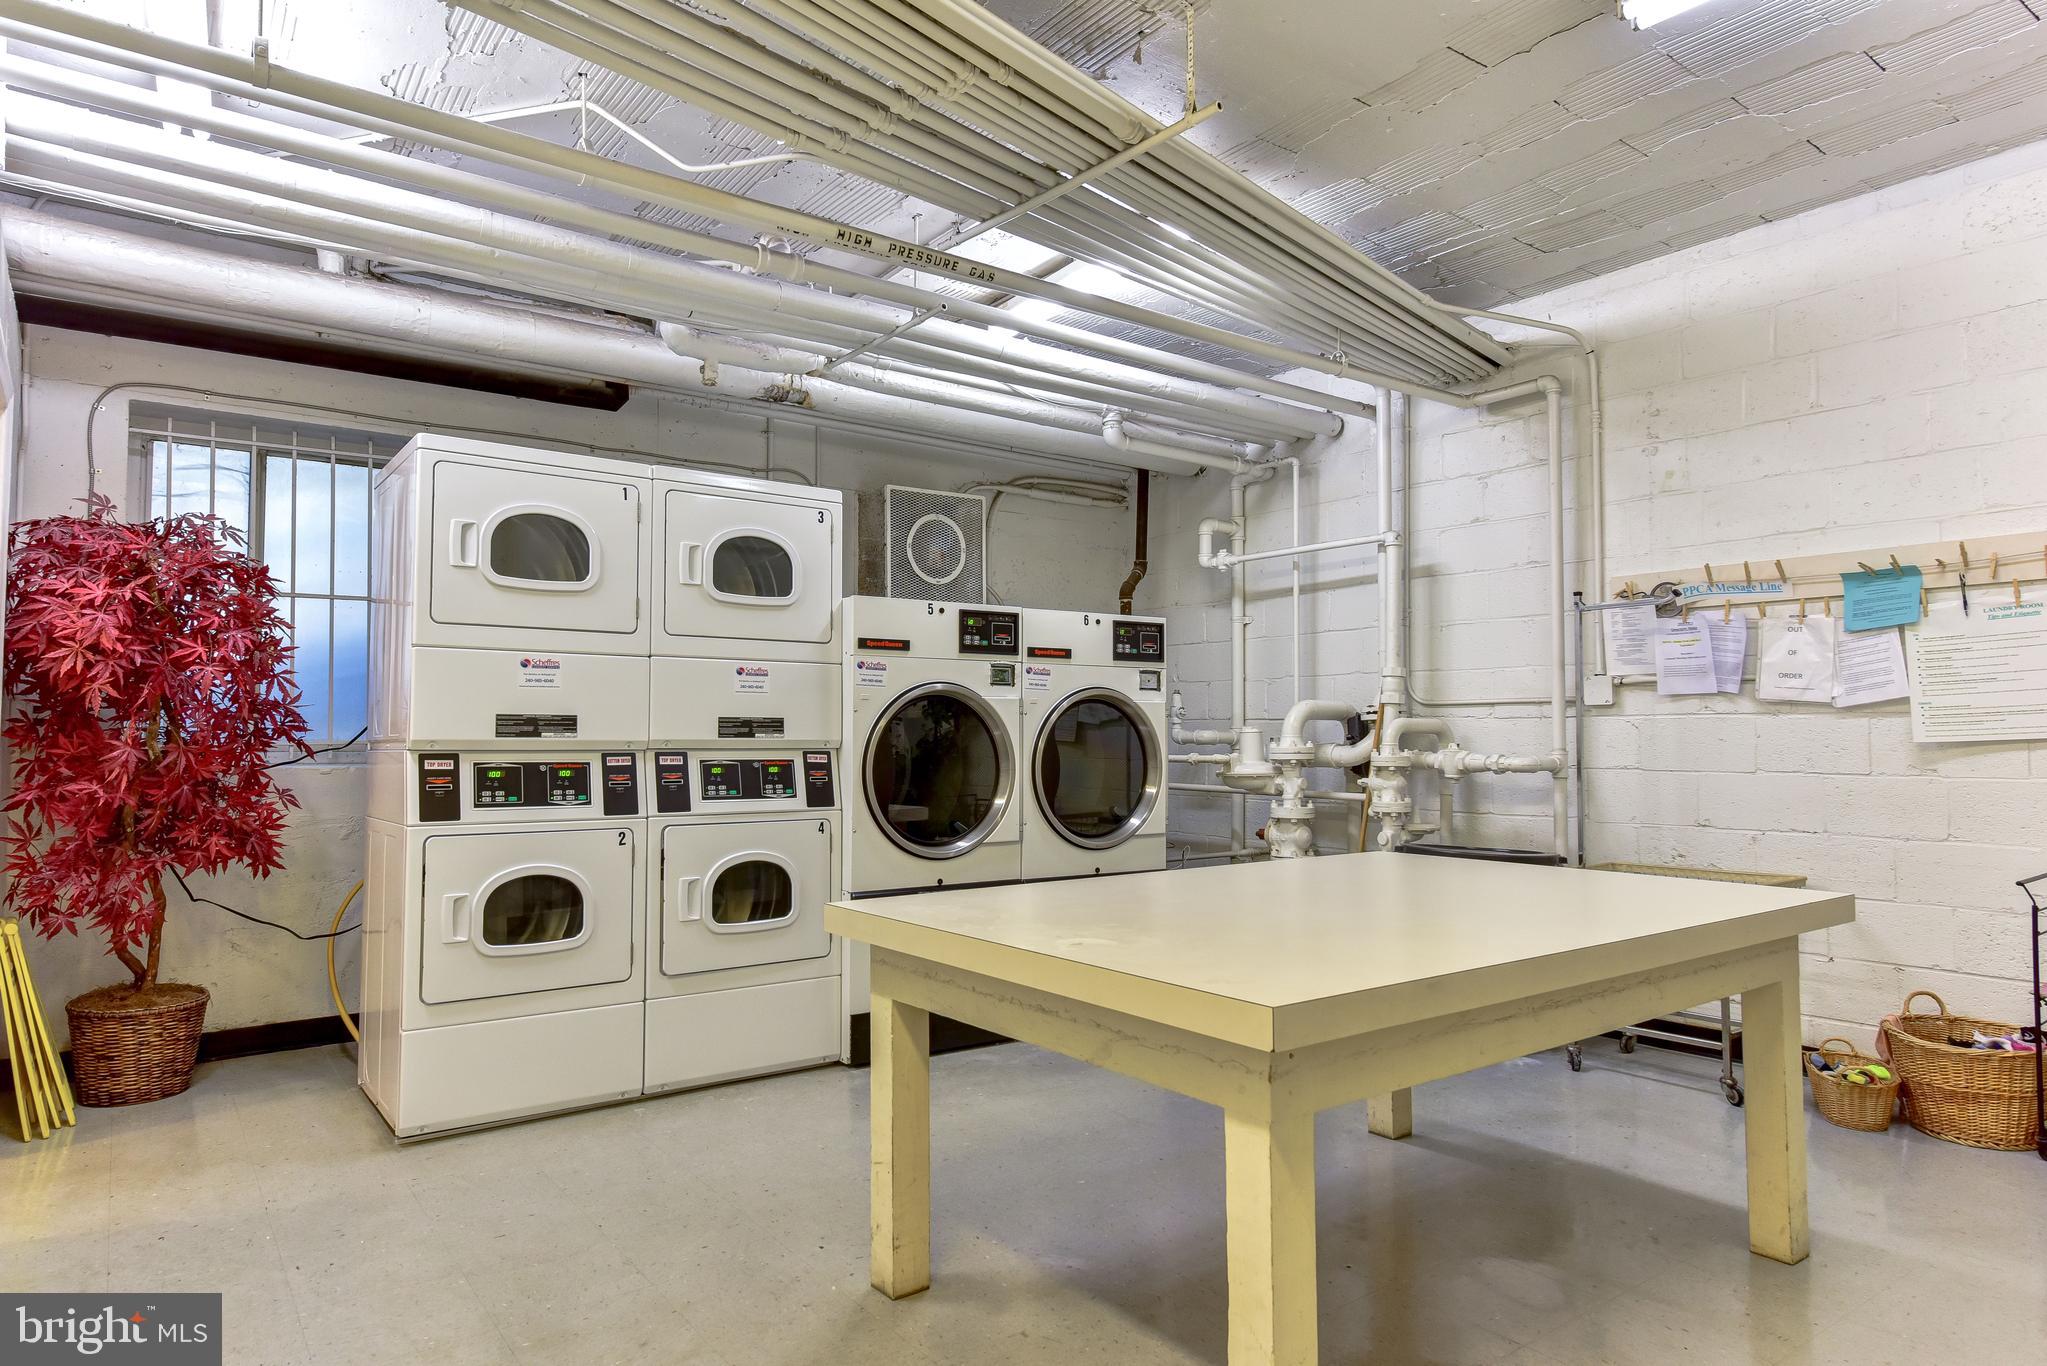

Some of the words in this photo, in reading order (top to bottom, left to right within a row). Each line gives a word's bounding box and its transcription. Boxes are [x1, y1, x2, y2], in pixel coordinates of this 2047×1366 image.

[836, 228, 874, 249] HIGH
[887, 242, 960, 272] PRESSURE
[968, 266, 996, 283] GAS
[622, 487, 628, 501] 1
[817, 511, 825, 524] 3
[1682, 584, 1713, 597] PPCA
[1715, 582, 1757, 593] Message
[1759, 581, 1783, 592] Line
[927, 603, 934, 615] 5
[1083, 614, 1090, 626] 6
[1778, 672, 1803, 680] ORDER
[818, 821, 825, 835] 4
[618, 831, 627, 846] 2
